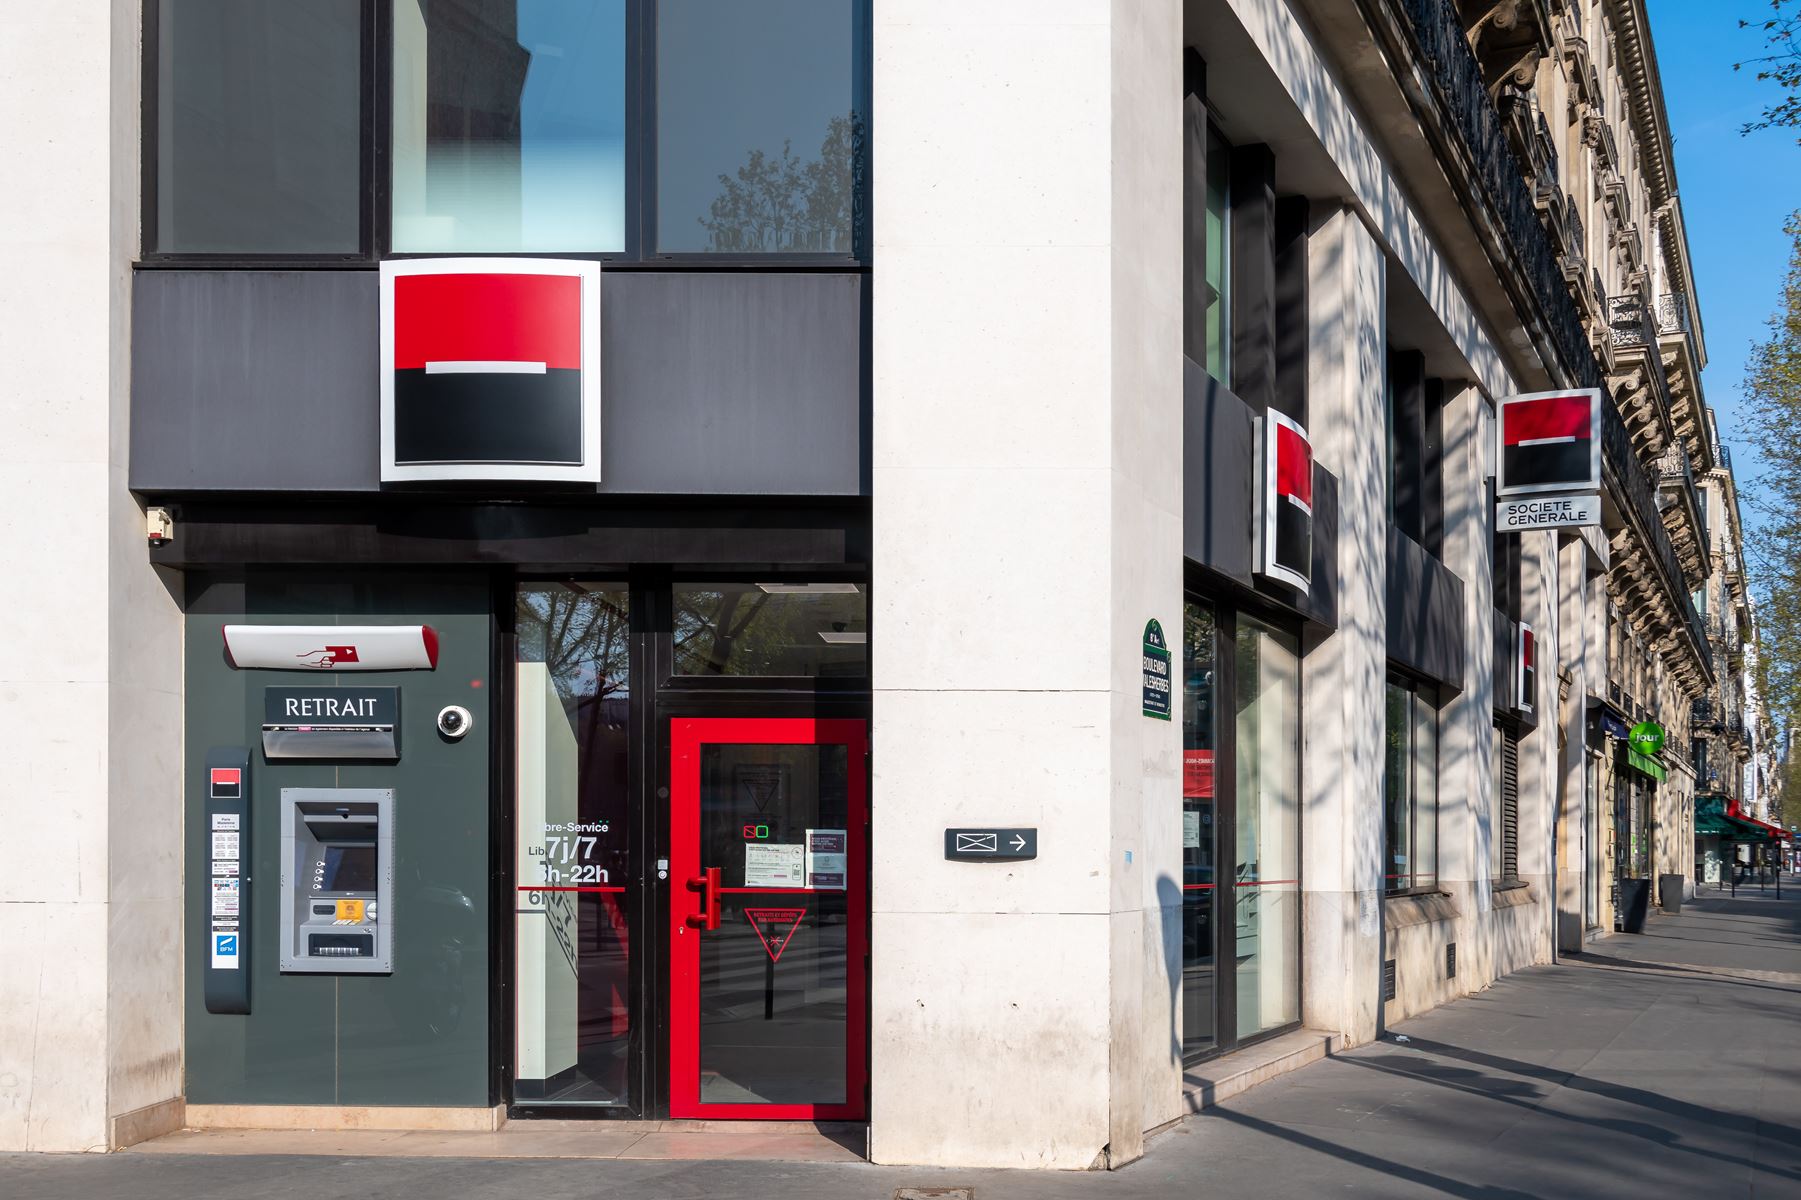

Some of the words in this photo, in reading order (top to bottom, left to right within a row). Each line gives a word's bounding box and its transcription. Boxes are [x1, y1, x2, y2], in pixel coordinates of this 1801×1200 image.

[1508, 501, 1572, 515] SOCIETE
[1508, 511, 1587, 526] GENERALE
[1143, 656, 1167, 675] BOULEVARD
[285, 698, 377, 717] RETRAIT
[1635, 732, 1660, 743] jour
[538, 822, 609, 832] bre-Service
[545, 836, 597, 864] 7j/7
